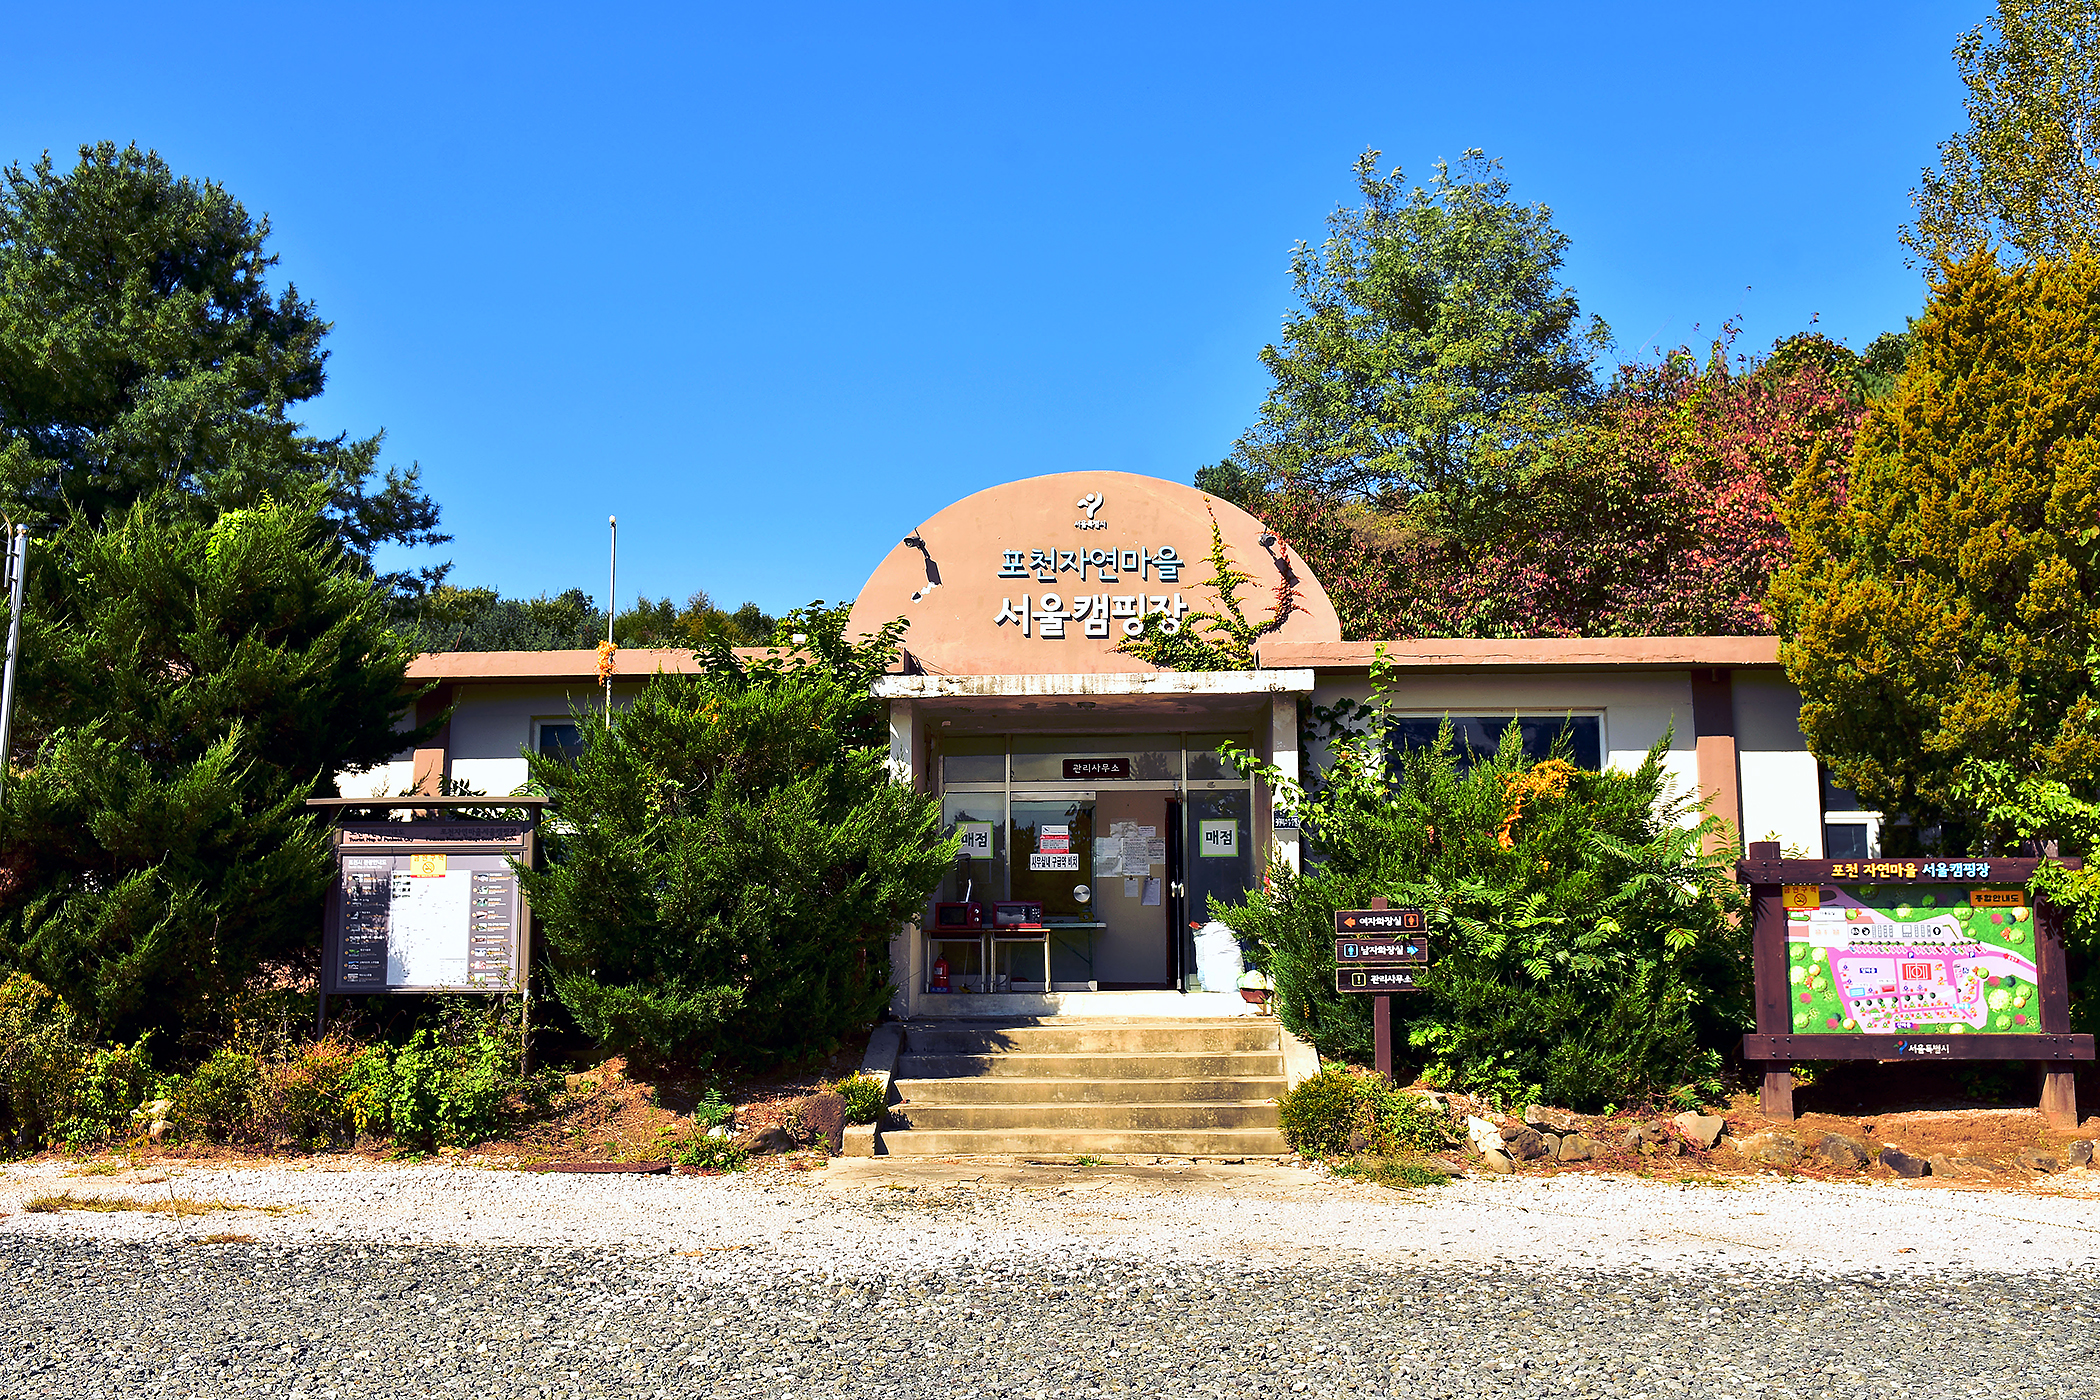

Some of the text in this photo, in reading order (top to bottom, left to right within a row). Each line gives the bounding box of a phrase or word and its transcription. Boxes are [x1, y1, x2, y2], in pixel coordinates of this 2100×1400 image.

[997, 545, 1185, 583] 포천자연마을
[993, 592, 1189, 638] 서울캠핑장
[1072, 763, 1120, 774] 관리사무소
[961, 831, 988, 848] 매점
[1205, 829, 1233, 846] 매점
[1031, 855, 1051, 868] 사무실내
[1830, 862, 1991, 879] 포천 자연마을 서울캠핑장
[1784, 886, 1817, 894] 금연구역
[1974, 893, 2020, 904] 종합안내도
[1359, 916, 1402, 927] 여자화장실
[1360, 944, 1404, 956] 남자화장실
[1370, 974, 1413, 985] 관리사무소
[1908, 1043, 1950, 1055] 서울특별시
